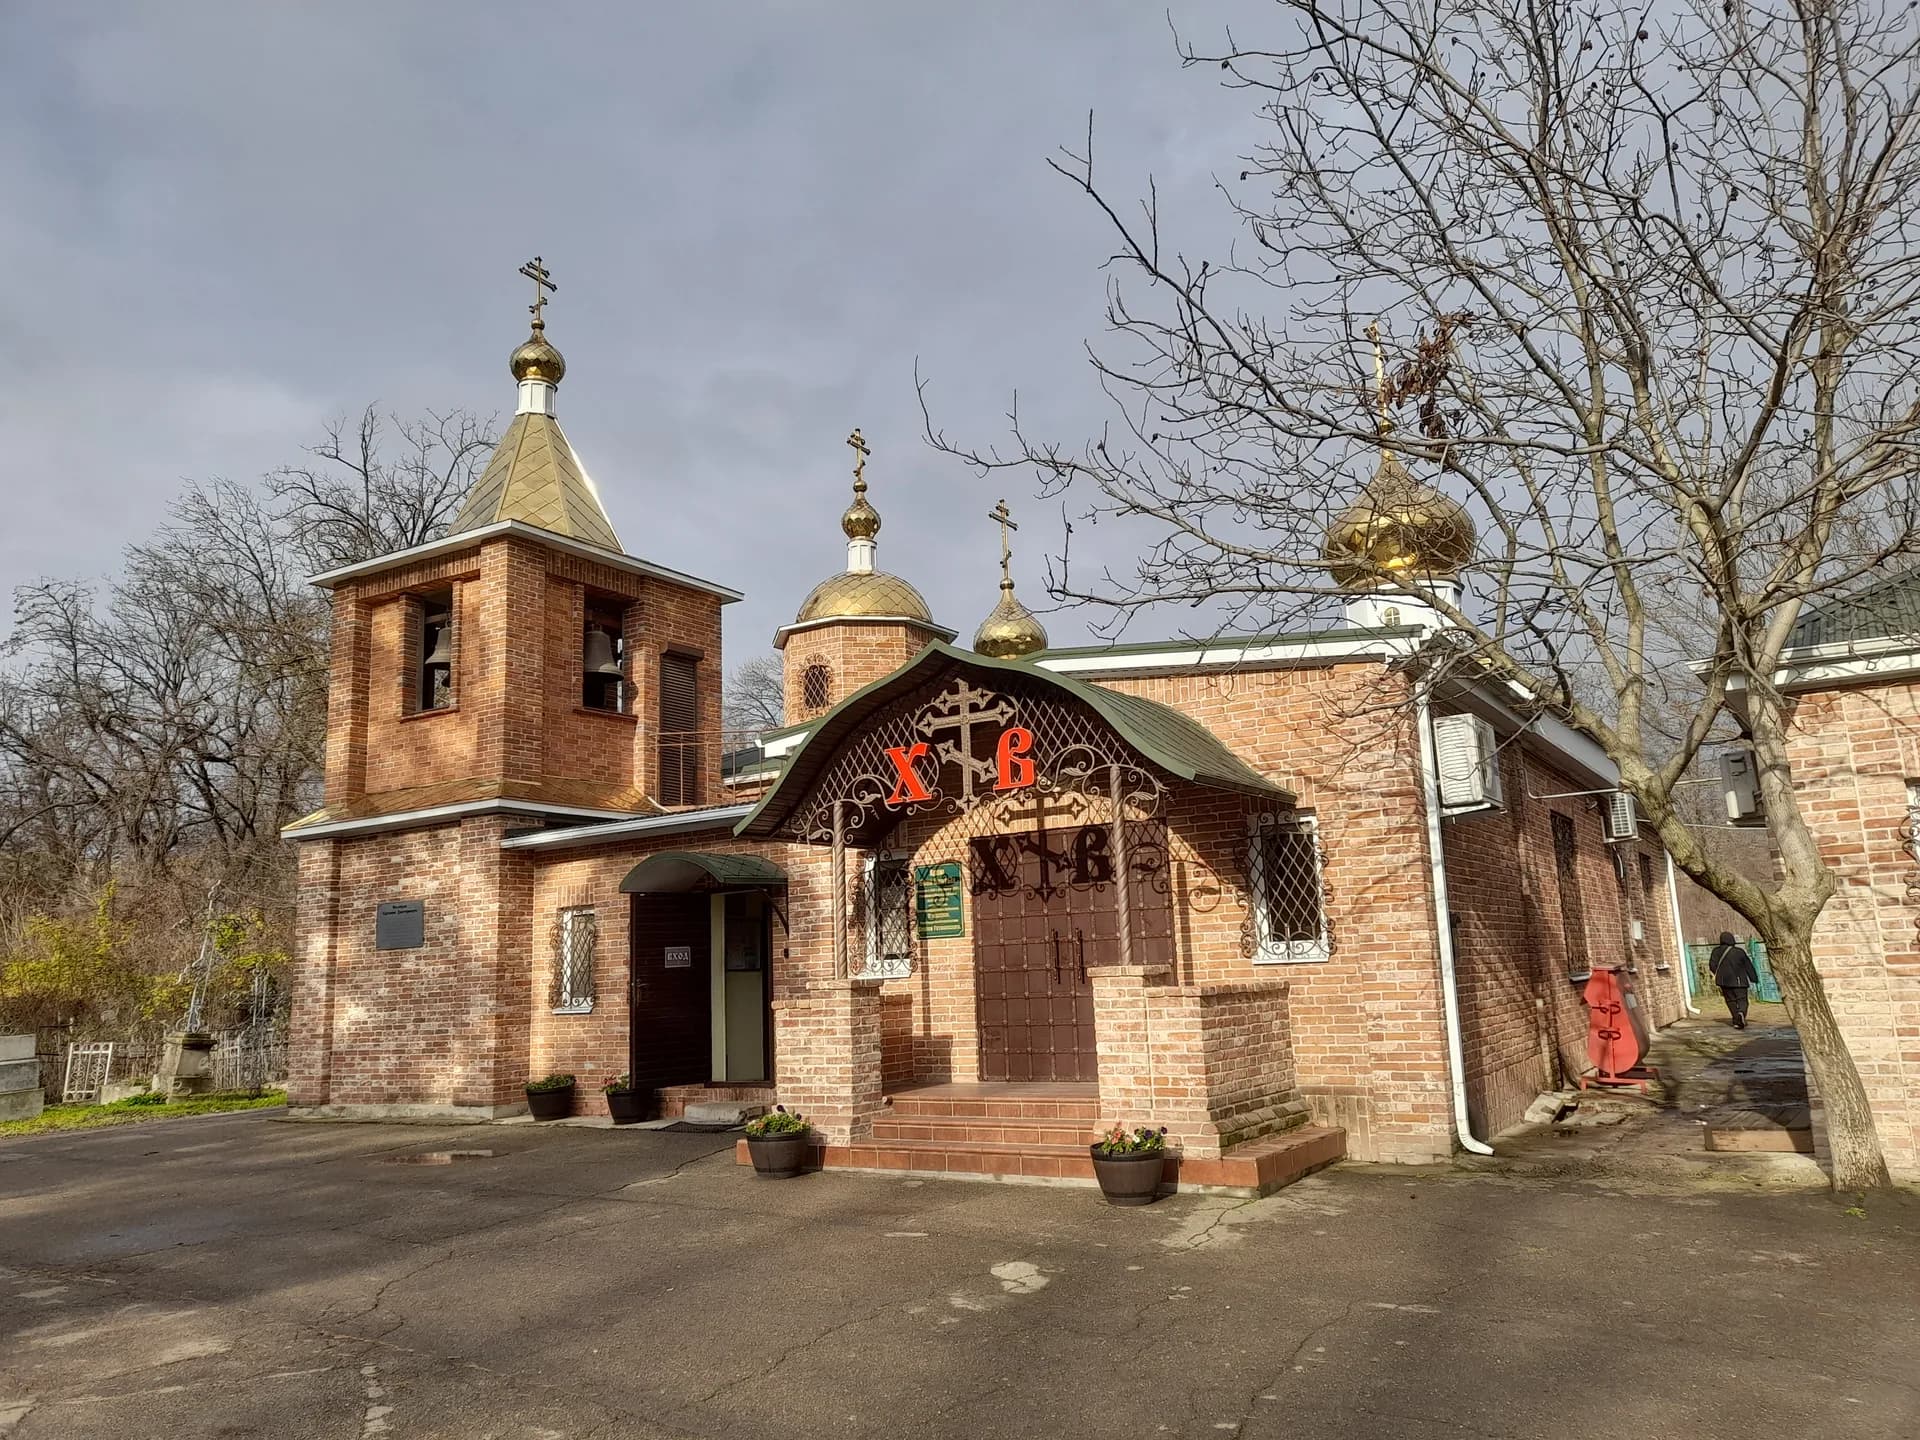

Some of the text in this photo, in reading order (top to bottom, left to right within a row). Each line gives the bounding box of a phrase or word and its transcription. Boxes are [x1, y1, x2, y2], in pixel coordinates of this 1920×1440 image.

[885, 728, 1035, 805] Х В
[667, 952, 689, 961] ВХОД
